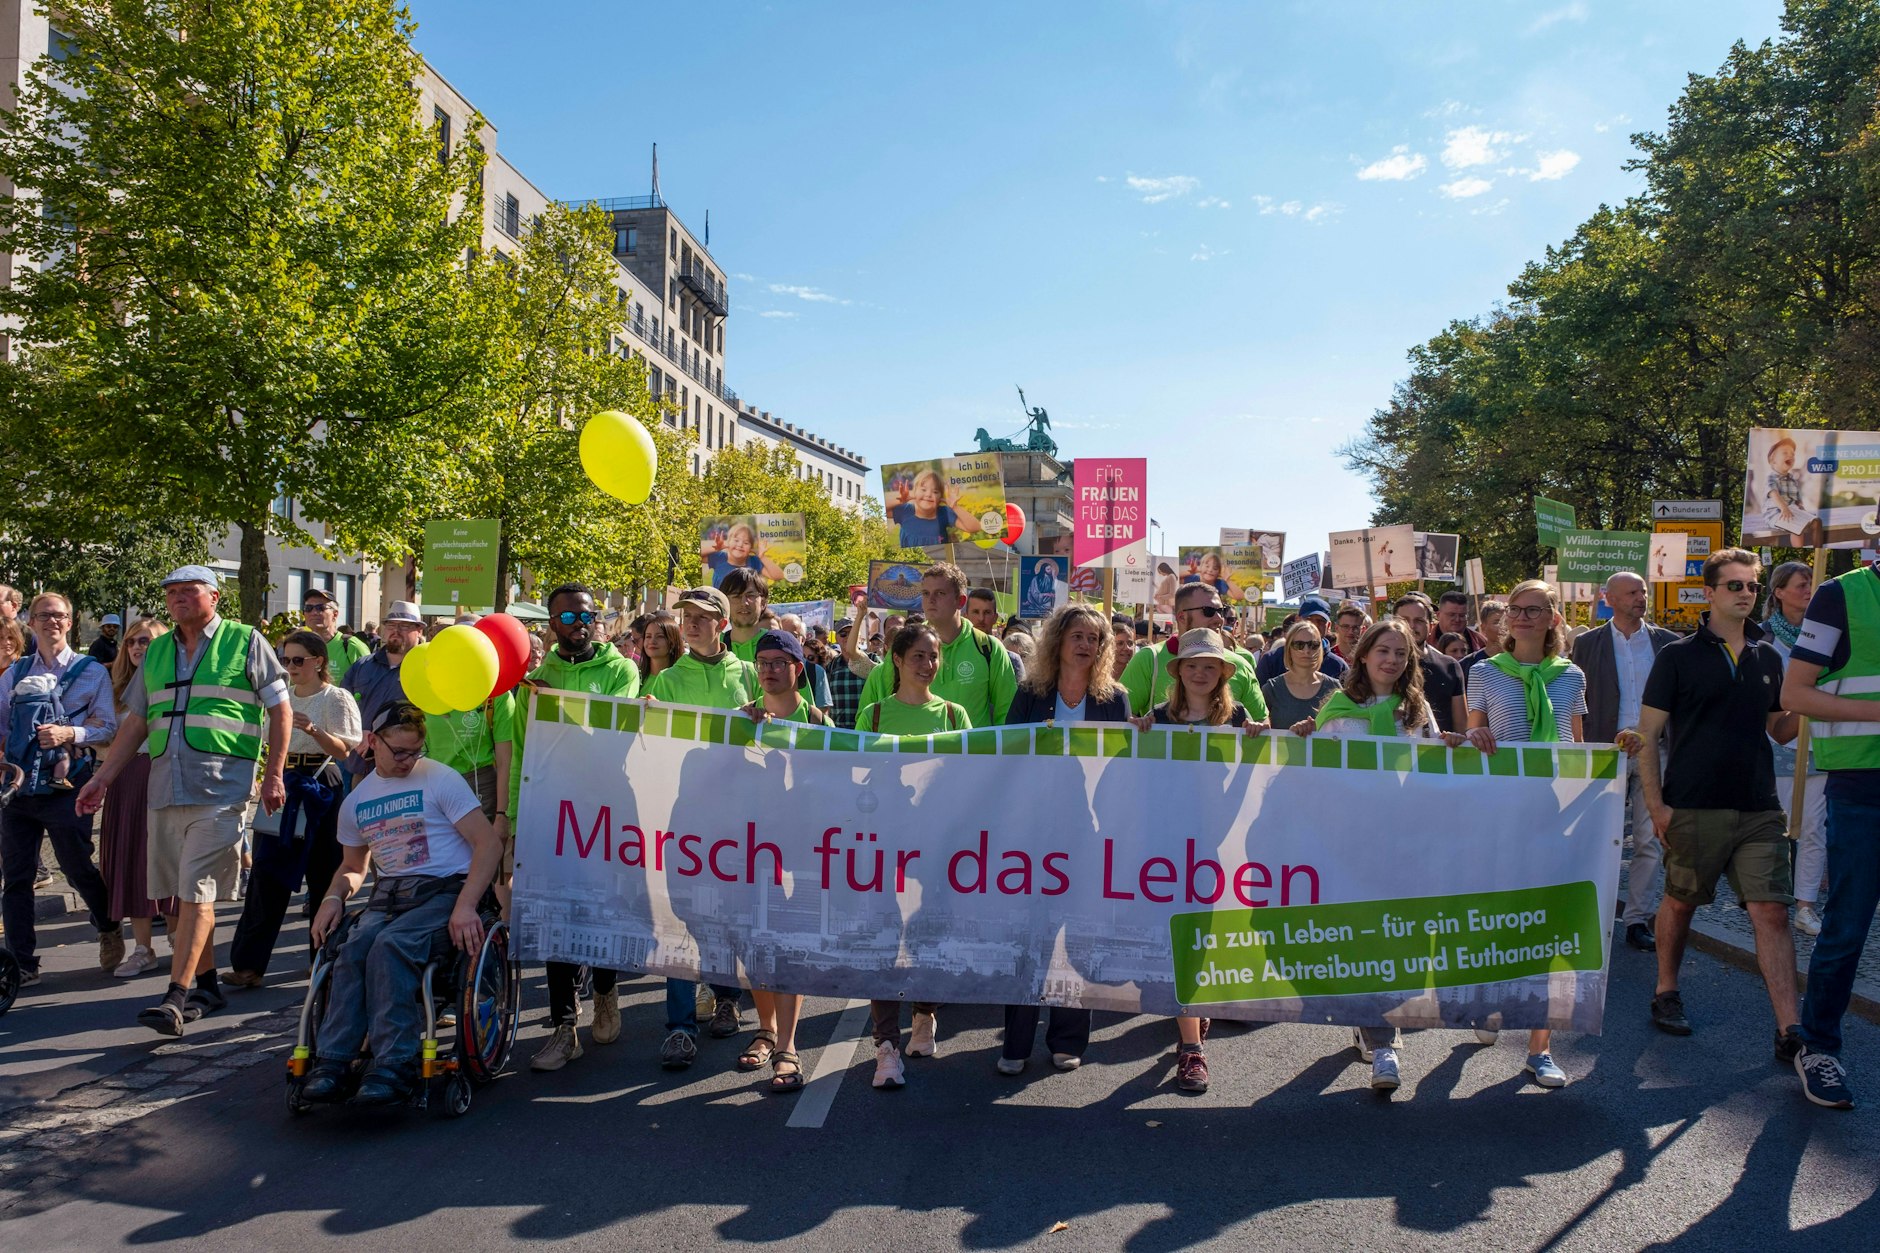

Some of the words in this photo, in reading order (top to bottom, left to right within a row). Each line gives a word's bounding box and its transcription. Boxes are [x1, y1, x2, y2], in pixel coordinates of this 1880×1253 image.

[959, 462, 972, 471] Ich
[976, 460, 989, 469] bin
[1812, 464, 1834, 472] WAR
[1841, 465, 1866, 475] PRO
[950, 472, 1000, 484] besonders!
[1096, 464, 1123, 482] FÜR
[1082, 487, 1139, 501] FRAUEN
[1082, 502, 1108, 520] FÜR
[1113, 506, 1138, 521] DAS
[760, 529, 802, 538] besonders!
[1087, 524, 1133, 539] LEBEN
[1358, 536, 1376, 544] Papa!
[1566, 535, 1644, 548] Willkommens-
[443, 552, 472, 561] Abtreibung
[1563, 548, 1594, 558] kultur
[1597, 550, 1624, 560] auch
[1628, 551, 1644, 560] für
[1291, 560, 1308, 570] kein
[1568, 561, 1635, 574] Ungeborene
[1285, 564, 1316, 580] mensch
[1292, 576, 1302, 585] ist
[1287, 583, 1304, 596] egal
[358, 804, 382, 823] HALLO
[384, 794, 419, 814] KINDER!
[554, 800, 782, 886] Marsch
[814, 826, 920, 893] für
[947, 830, 1070, 896] das
[1103, 838, 1320, 907] Leben
[1192, 926, 1218, 951] Ja
[1226, 929, 1275, 948] zum
[1283, 922, 1353, 945] Leben
[1382, 914, 1416, 938] für
[1423, 912, 1460, 936] ein
[1468, 908, 1547, 934] Europa
[1195, 963, 1253, 988] ohne
[1262, 956, 1396, 982] Abtreibung
[1404, 952, 1449, 974] und
[1456, 933, 1581, 970] Euthanasie!
